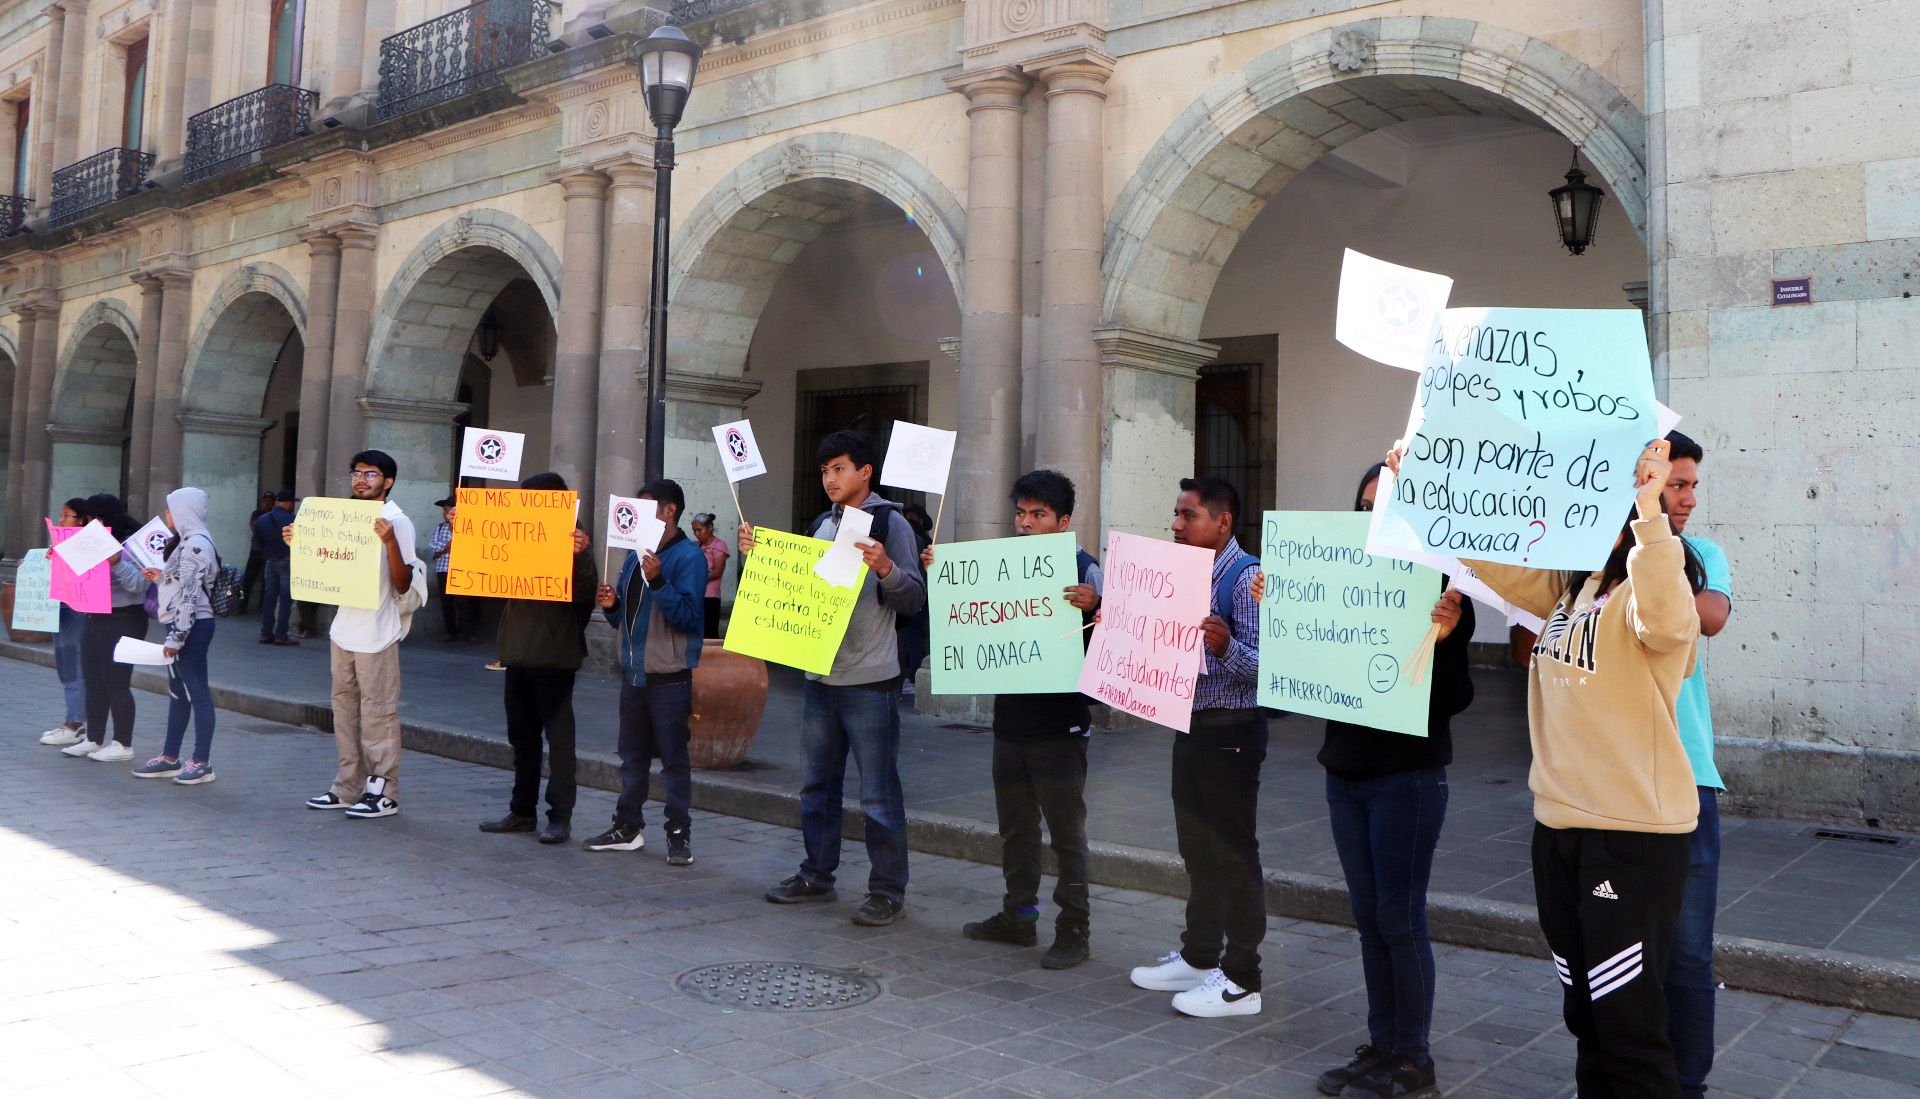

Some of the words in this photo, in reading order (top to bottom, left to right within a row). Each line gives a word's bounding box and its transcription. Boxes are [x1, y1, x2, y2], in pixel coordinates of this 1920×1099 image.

[1421, 362, 1501, 408] golpes
[1513, 389, 1527, 420] y
[1533, 381, 1640, 420] robos
[1473, 431, 1554, 479] parte
[1566, 438, 1610, 493] de
[485, 490, 512, 508] MAS
[1422, 472, 1546, 519] educación
[1564, 502, 1600, 529] en
[321, 523, 334, 538] los
[454, 516, 474, 536] CIA
[481, 519, 547, 543] CONTRA
[753, 528, 812, 556] Exigimos
[482, 543, 510, 562] LOS
[791, 561, 809, 576] del
[449, 568, 569, 601] ESTUDIANTES!
[745, 568, 806, 598] investigue
[810, 582, 826, 604] las
[937, 559, 980, 586] ALTO
[997, 557, 1011, 582] A
[1022, 554, 1055, 580] LAS
[1265, 573, 1326, 605] agresión
[1342, 580, 1406, 609] contra
[738, 589, 761, 604] nes
[765, 597, 810, 617] contra
[817, 605, 834, 626] los
[948, 595, 1054, 627] AGRESIONES
[1268, 607, 1288, 639] los
[1152, 617, 1200, 654] para
[944, 645, 965, 671] EN
[976, 639, 1043, 671] OAXACA
[1096, 638, 1114, 675] los
